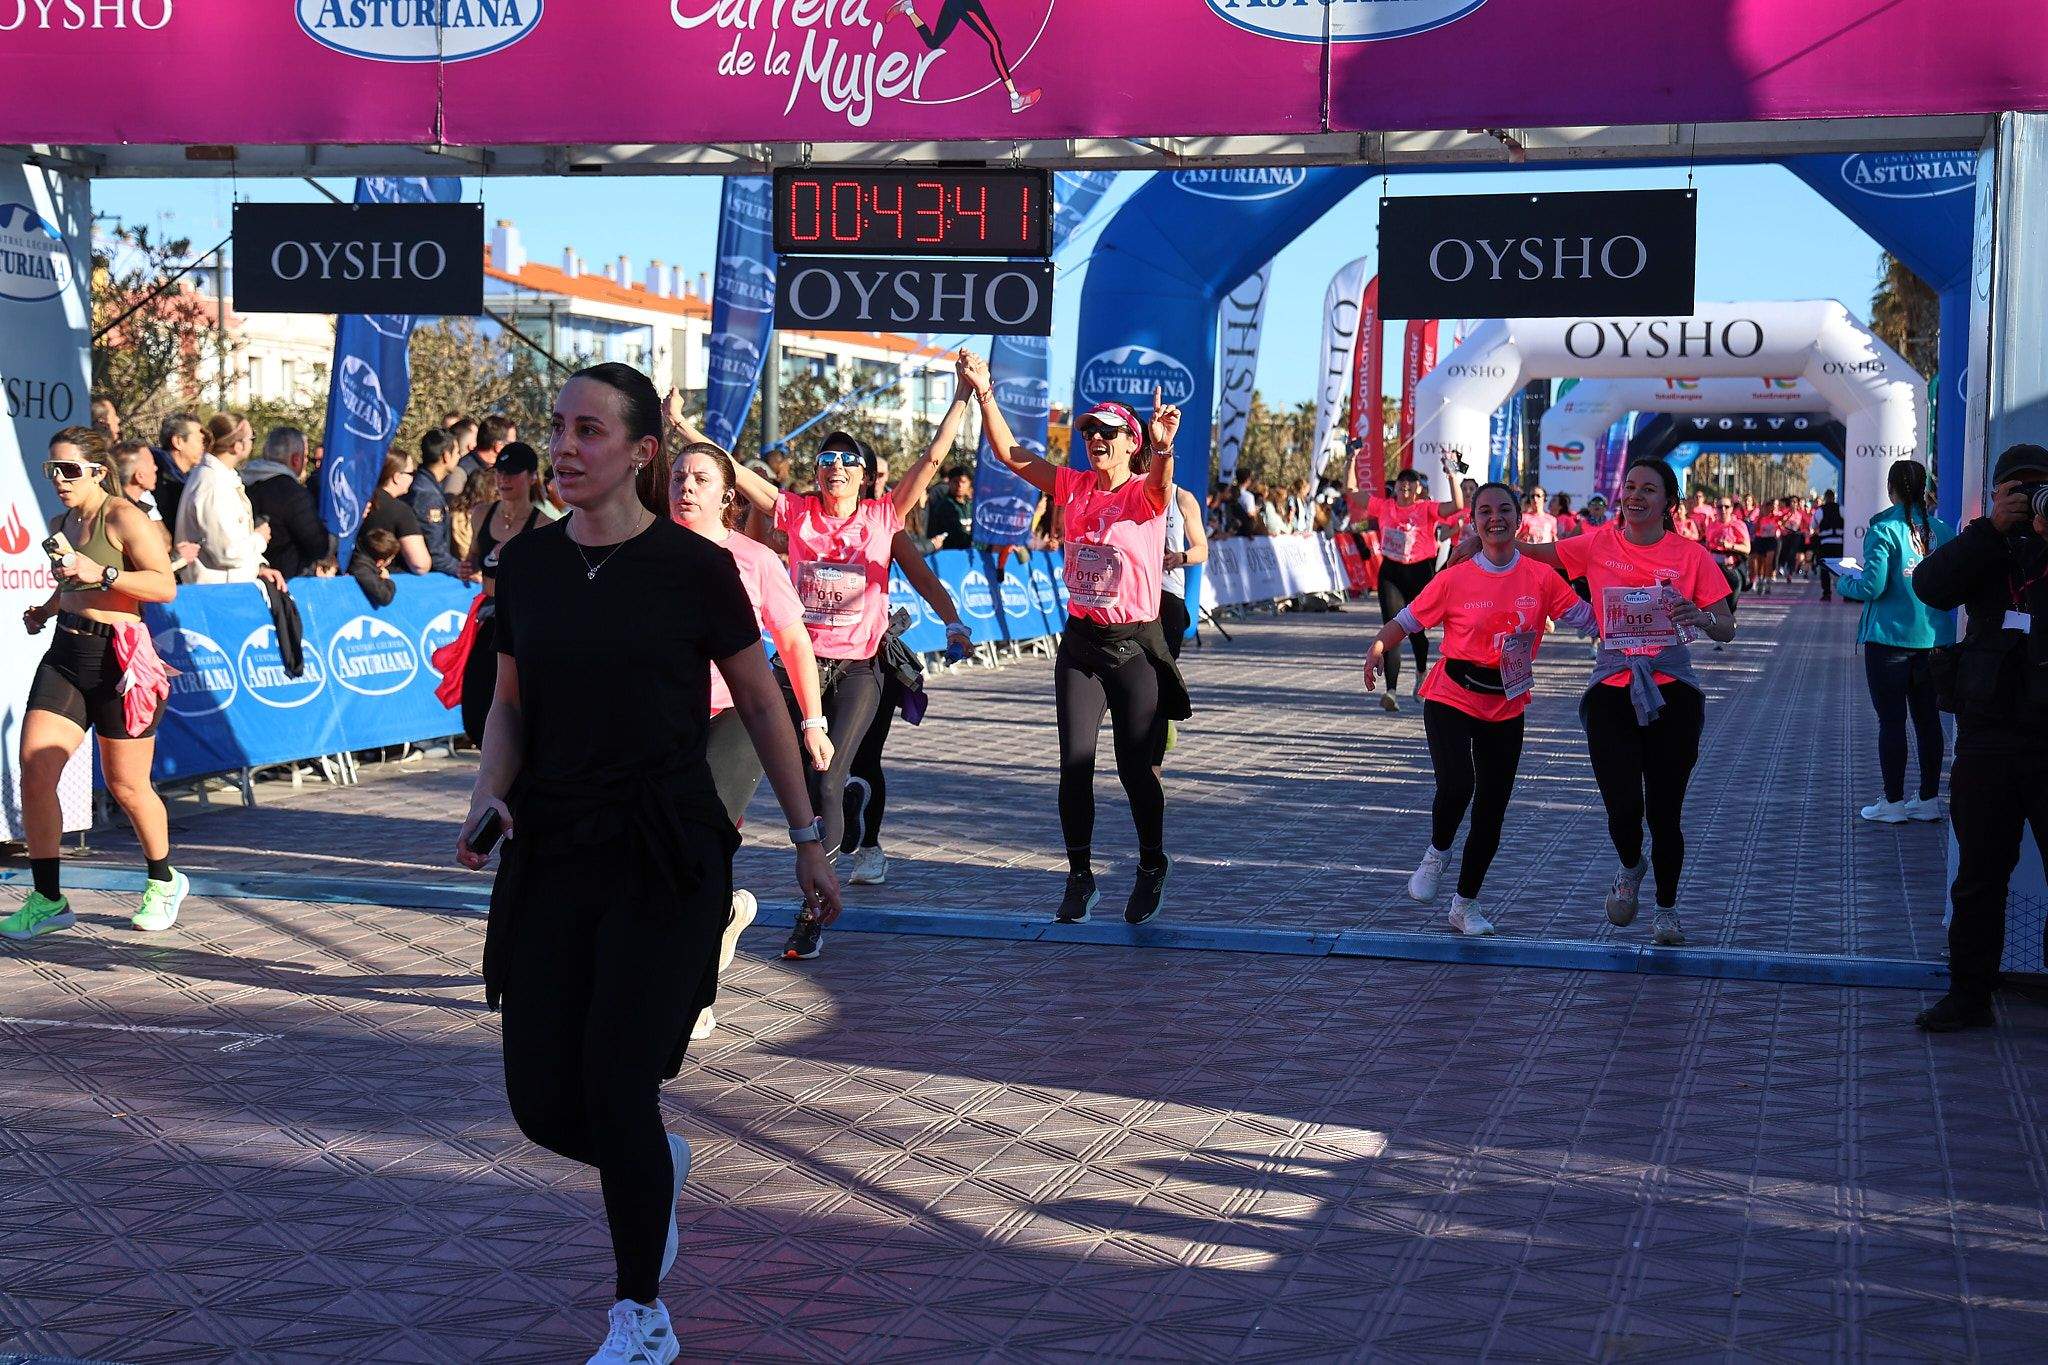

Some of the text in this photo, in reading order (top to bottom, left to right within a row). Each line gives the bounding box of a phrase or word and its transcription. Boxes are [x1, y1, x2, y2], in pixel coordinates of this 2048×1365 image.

[718, 22, 947, 127] de la Mujer
[1181, 167, 1295, 185] ASTURIANA
[790, 181, 1029, 242] 00:43:41
[271, 240, 447, 281] OYSHO
[1429, 235, 1647, 282] OYSHO
[789, 268, 1039, 325] OYSHO
[1564, 319, 1764, 359] OYSHO
[1357, 308, 1375, 410] Santander
[1448, 364, 1505, 378] OYSHO
[1823, 360, 1885, 375] OYSHO
[1084, 369, 1186, 398] ASTURIANA
[0, 377, 74, 422] SHO
[1692, 417, 1809, 430] VOLVO
[1076, 570, 1100, 583] 016
[1605, 559, 1634, 573] OYSHO
[817, 589, 843, 602] 016
[1463, 600, 1494, 610] OYSHO
[1626, 613, 1653, 625] 016
[337, 648, 414, 680] ASTURIANA
